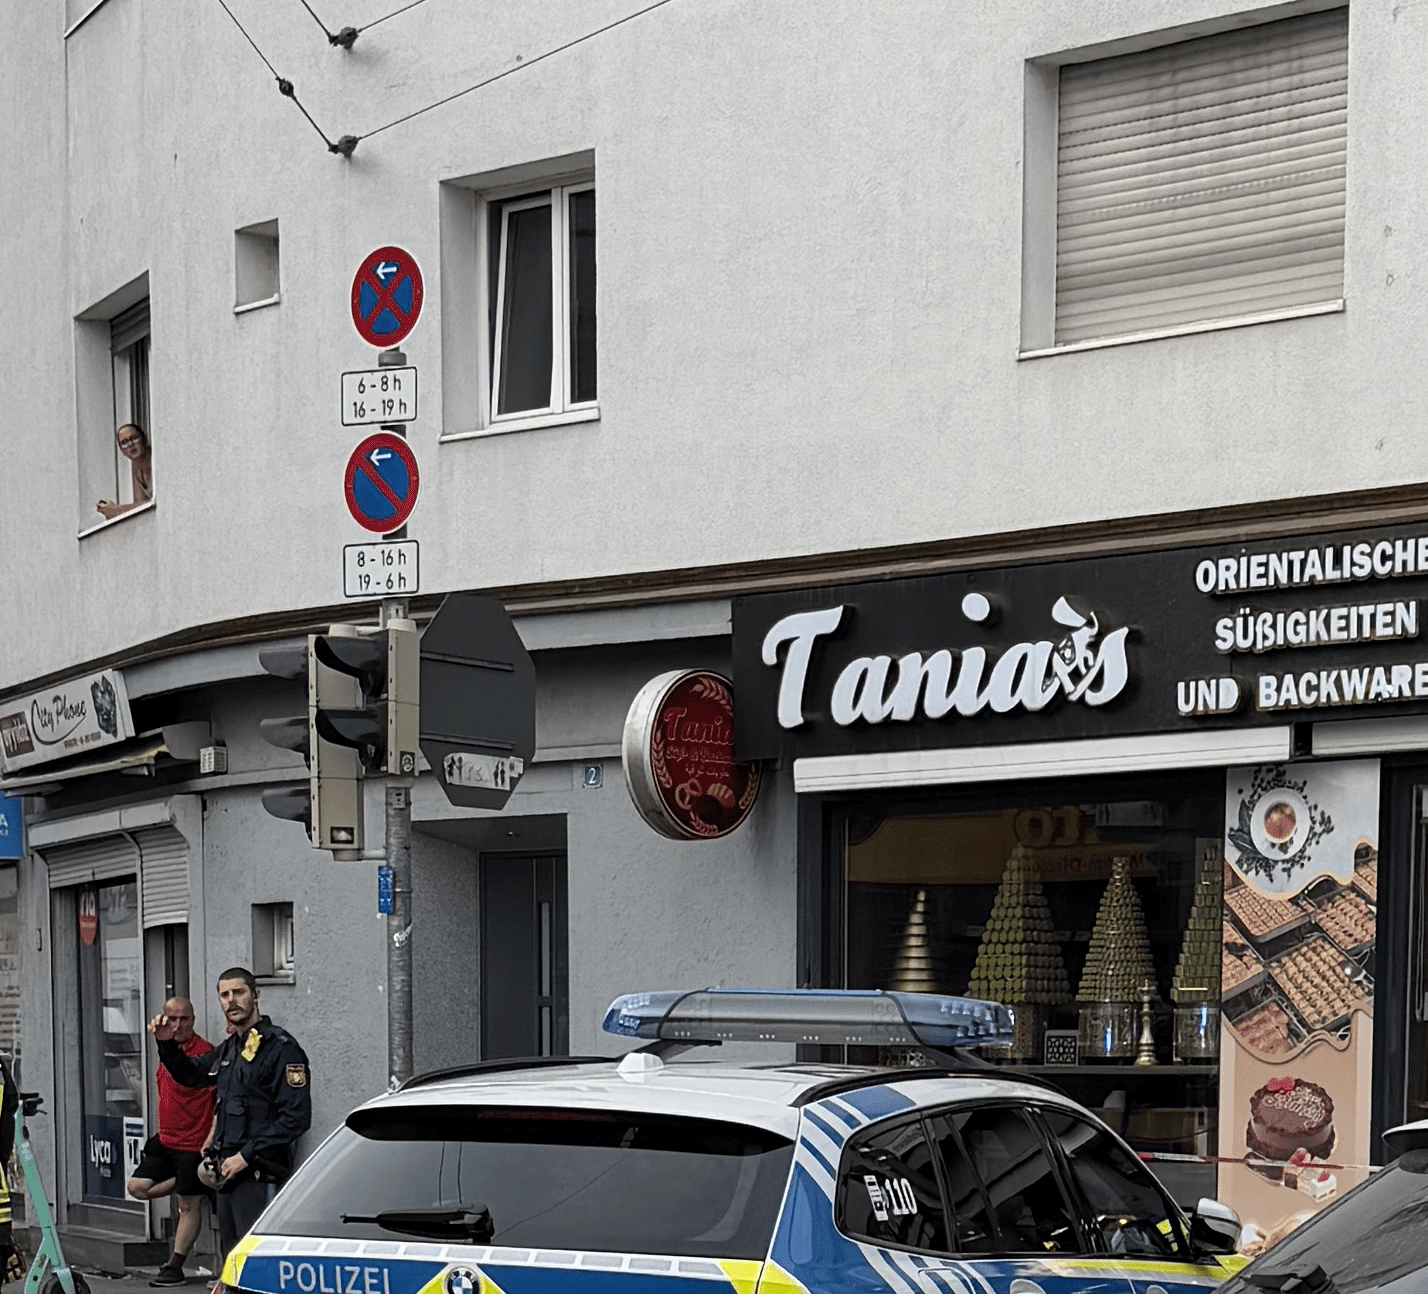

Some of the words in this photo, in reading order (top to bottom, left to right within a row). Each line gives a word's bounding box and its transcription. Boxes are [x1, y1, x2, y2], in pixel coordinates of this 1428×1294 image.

[358, 377, 366, 394] 6
[380, 375, 389, 392] 8
[393, 374, 402, 391] h
[353, 401, 366, 419] 16
[381, 398, 395, 416] 19
[399, 398, 407, 415] h
[357, 551, 365, 567] 8
[380, 549, 394, 567] 16
[398, 548, 406, 565] h
[358, 573, 371, 591] 19
[385, 572, 394, 589] 6
[398, 572, 406, 589] h
[1176, 675, 1240, 714] UND
[589, 767, 597, 785] 2
[90, 1135, 112, 1170] Lyca
[884, 1178, 918, 1216] 110
